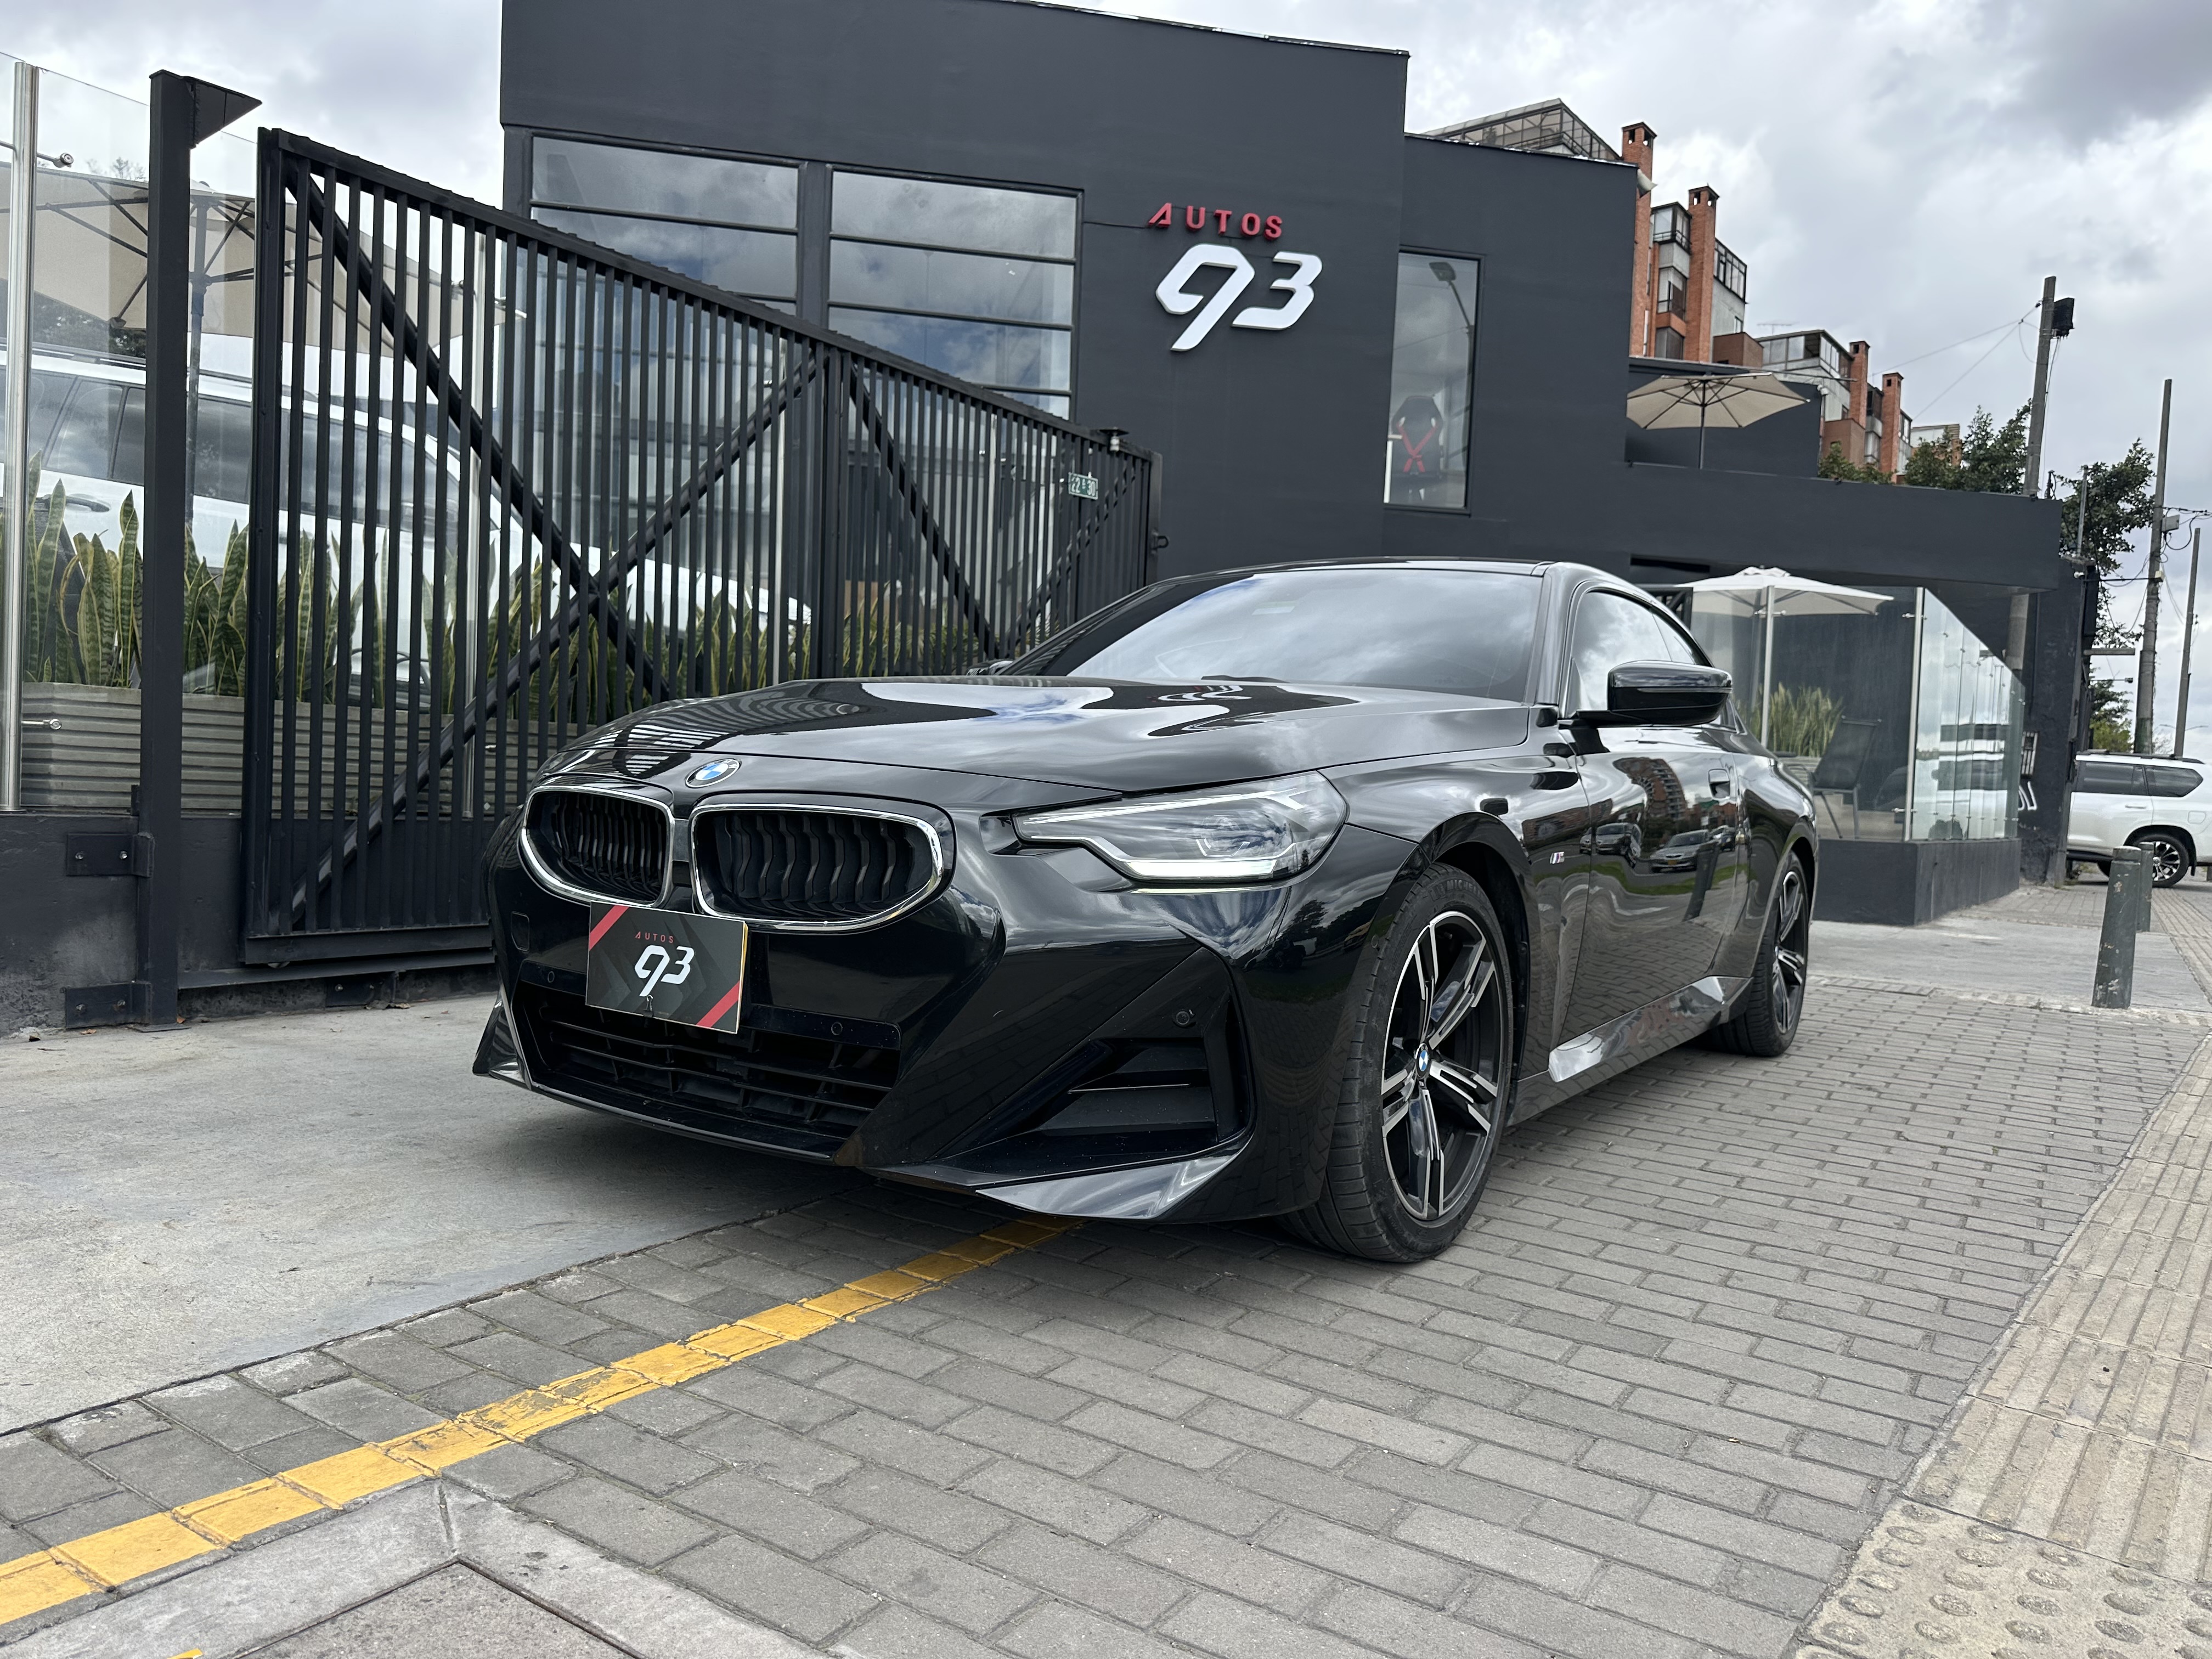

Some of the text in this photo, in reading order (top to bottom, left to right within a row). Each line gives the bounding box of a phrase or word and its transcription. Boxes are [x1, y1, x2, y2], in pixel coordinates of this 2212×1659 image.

[1148, 202, 1283, 240] AUTOS
[1155, 242, 1323, 352] 93
[634, 931, 674, 944] AUTOS
[634, 944, 695, 997] 93
